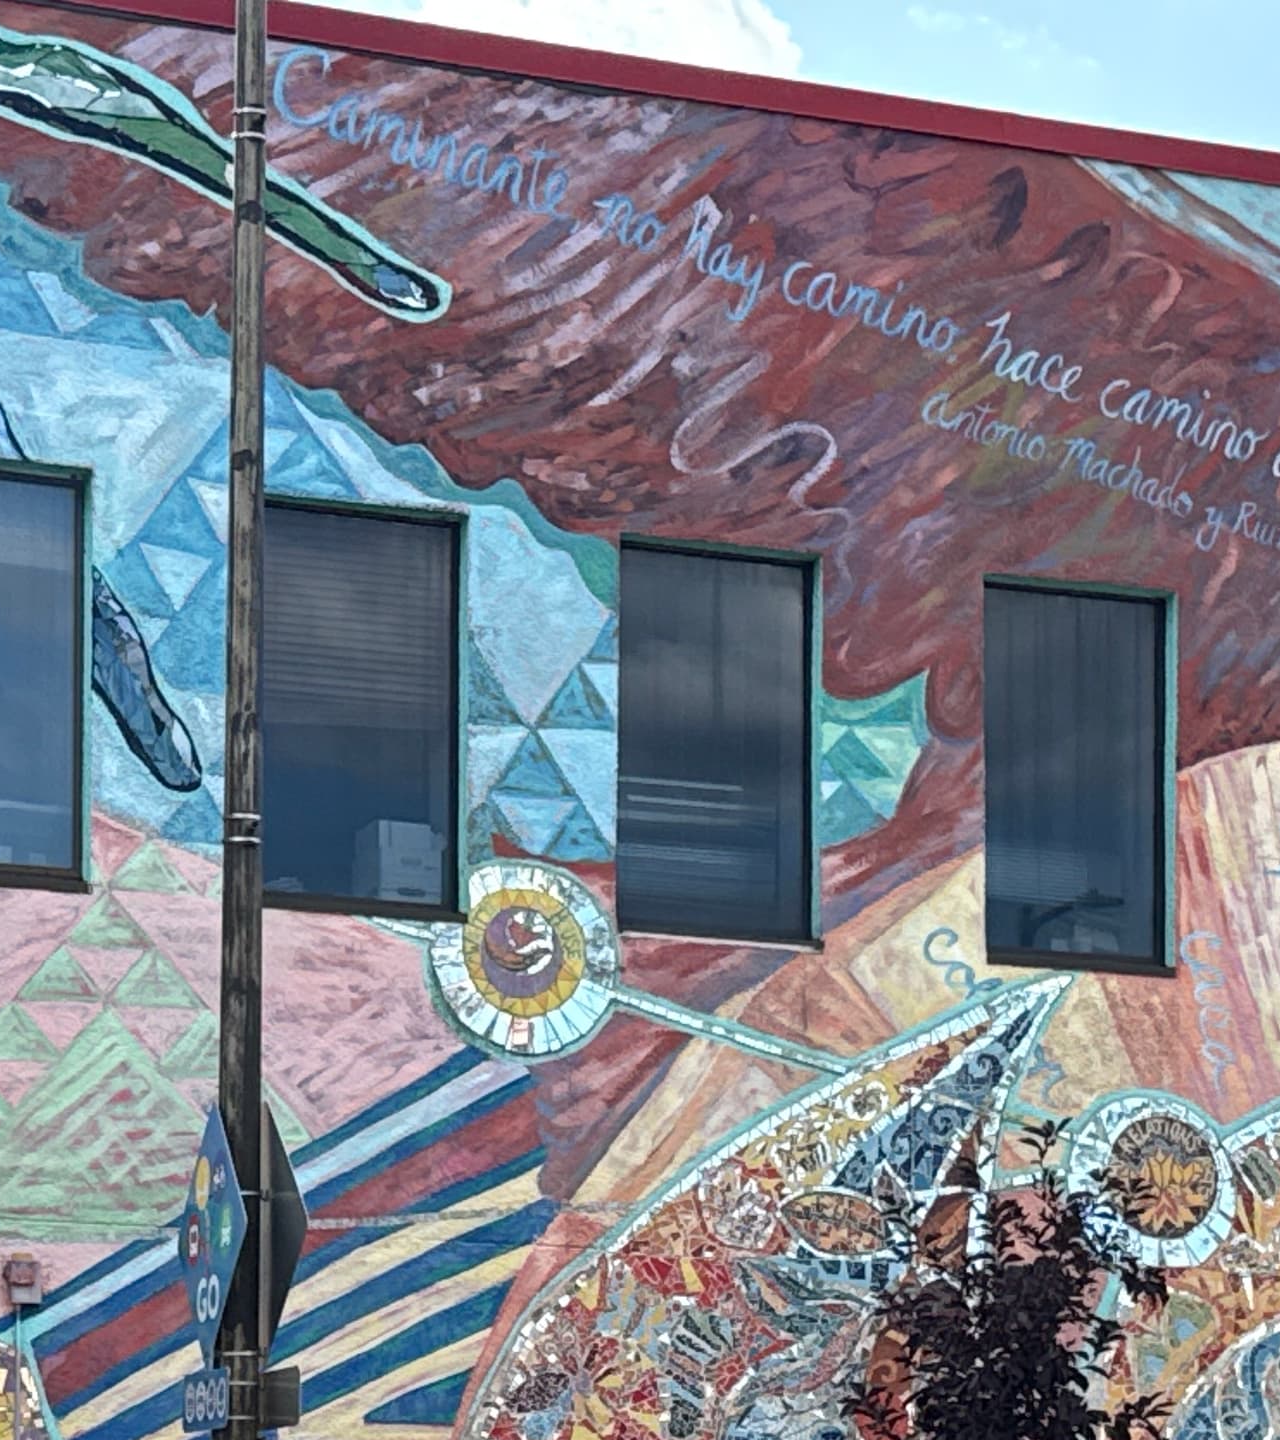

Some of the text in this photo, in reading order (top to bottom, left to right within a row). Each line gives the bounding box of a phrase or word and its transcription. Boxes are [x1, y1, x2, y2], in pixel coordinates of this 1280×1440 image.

[594, 197, 667, 255] no
[685, 194, 767, 324] hay
[978, 312, 1084, 401] hace
[1100, 379, 1269, 463] camino
[1063, 433, 1194, 516] Machado
[1195, 506, 1226, 552] y
[196, 1273, 220, 1324] GO
